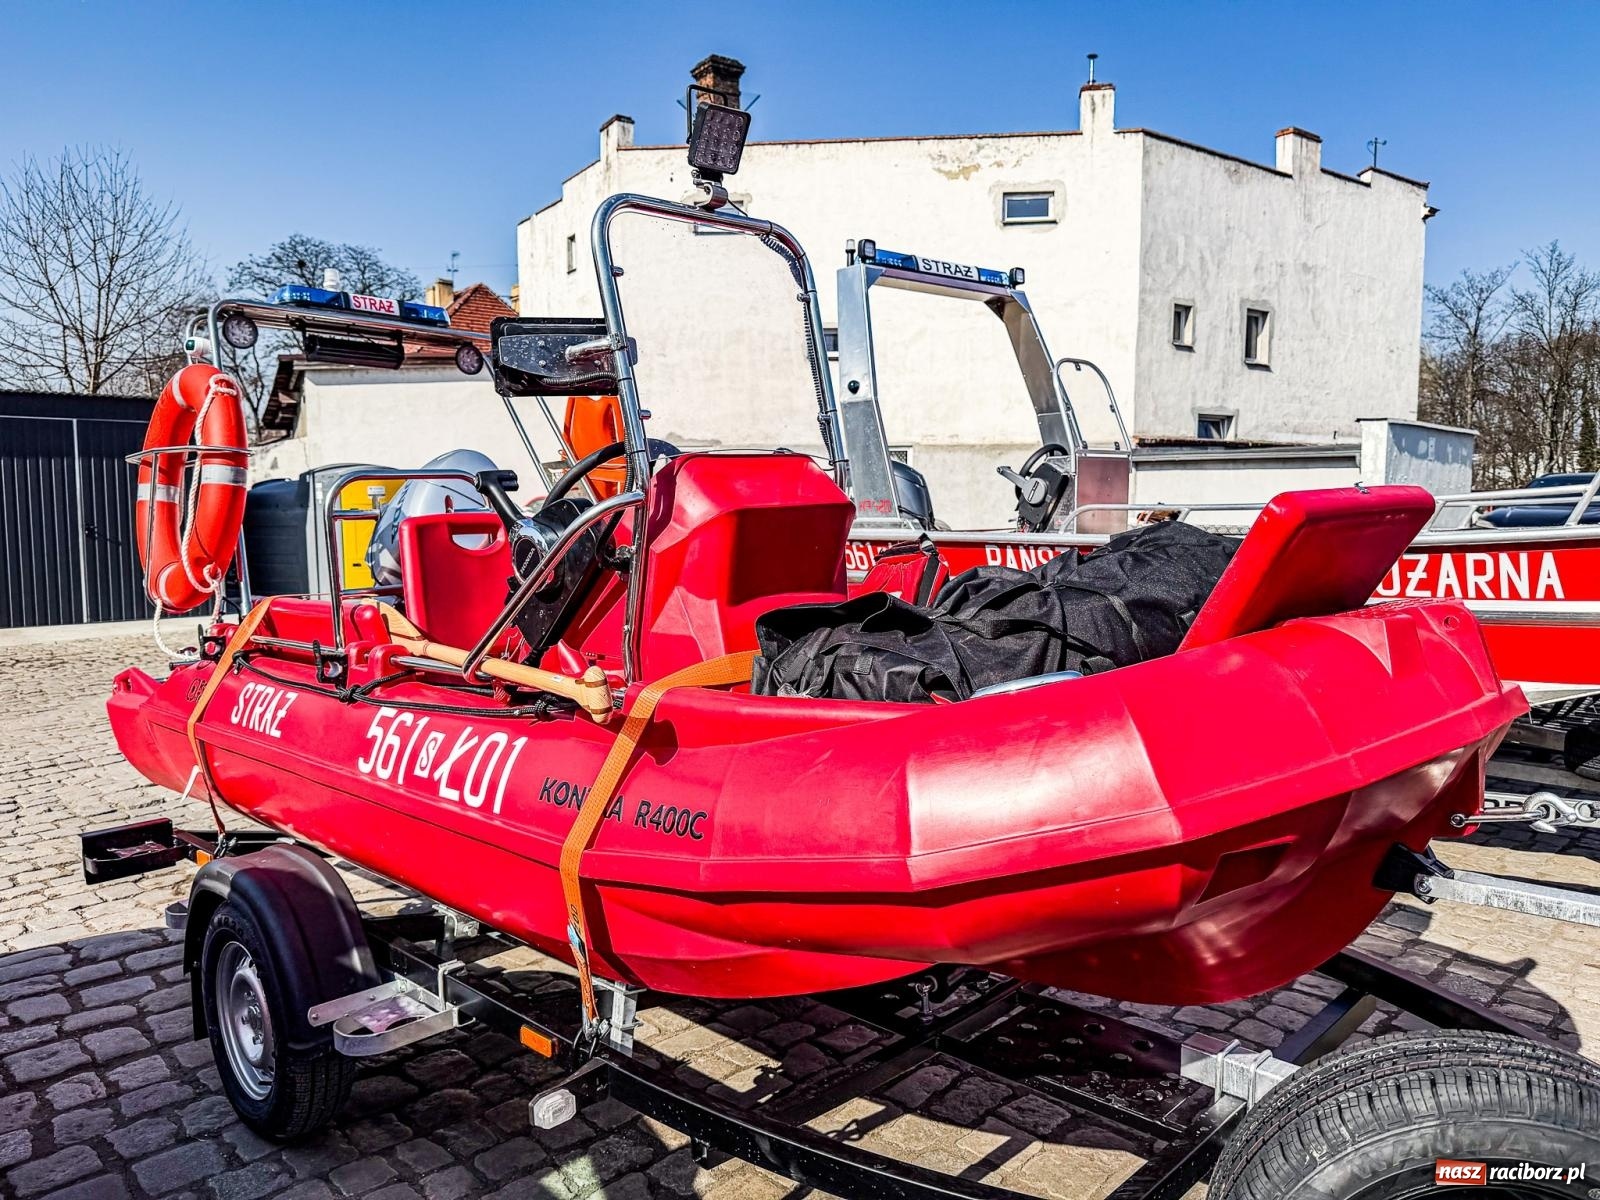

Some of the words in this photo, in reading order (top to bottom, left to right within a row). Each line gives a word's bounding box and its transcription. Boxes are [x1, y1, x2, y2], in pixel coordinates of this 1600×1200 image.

[520, 547, 536, 575] HONDA
[230, 682, 299, 738] STRAŻ
[538, 776, 625, 822] KONA
[634, 800, 708, 840] R400C
